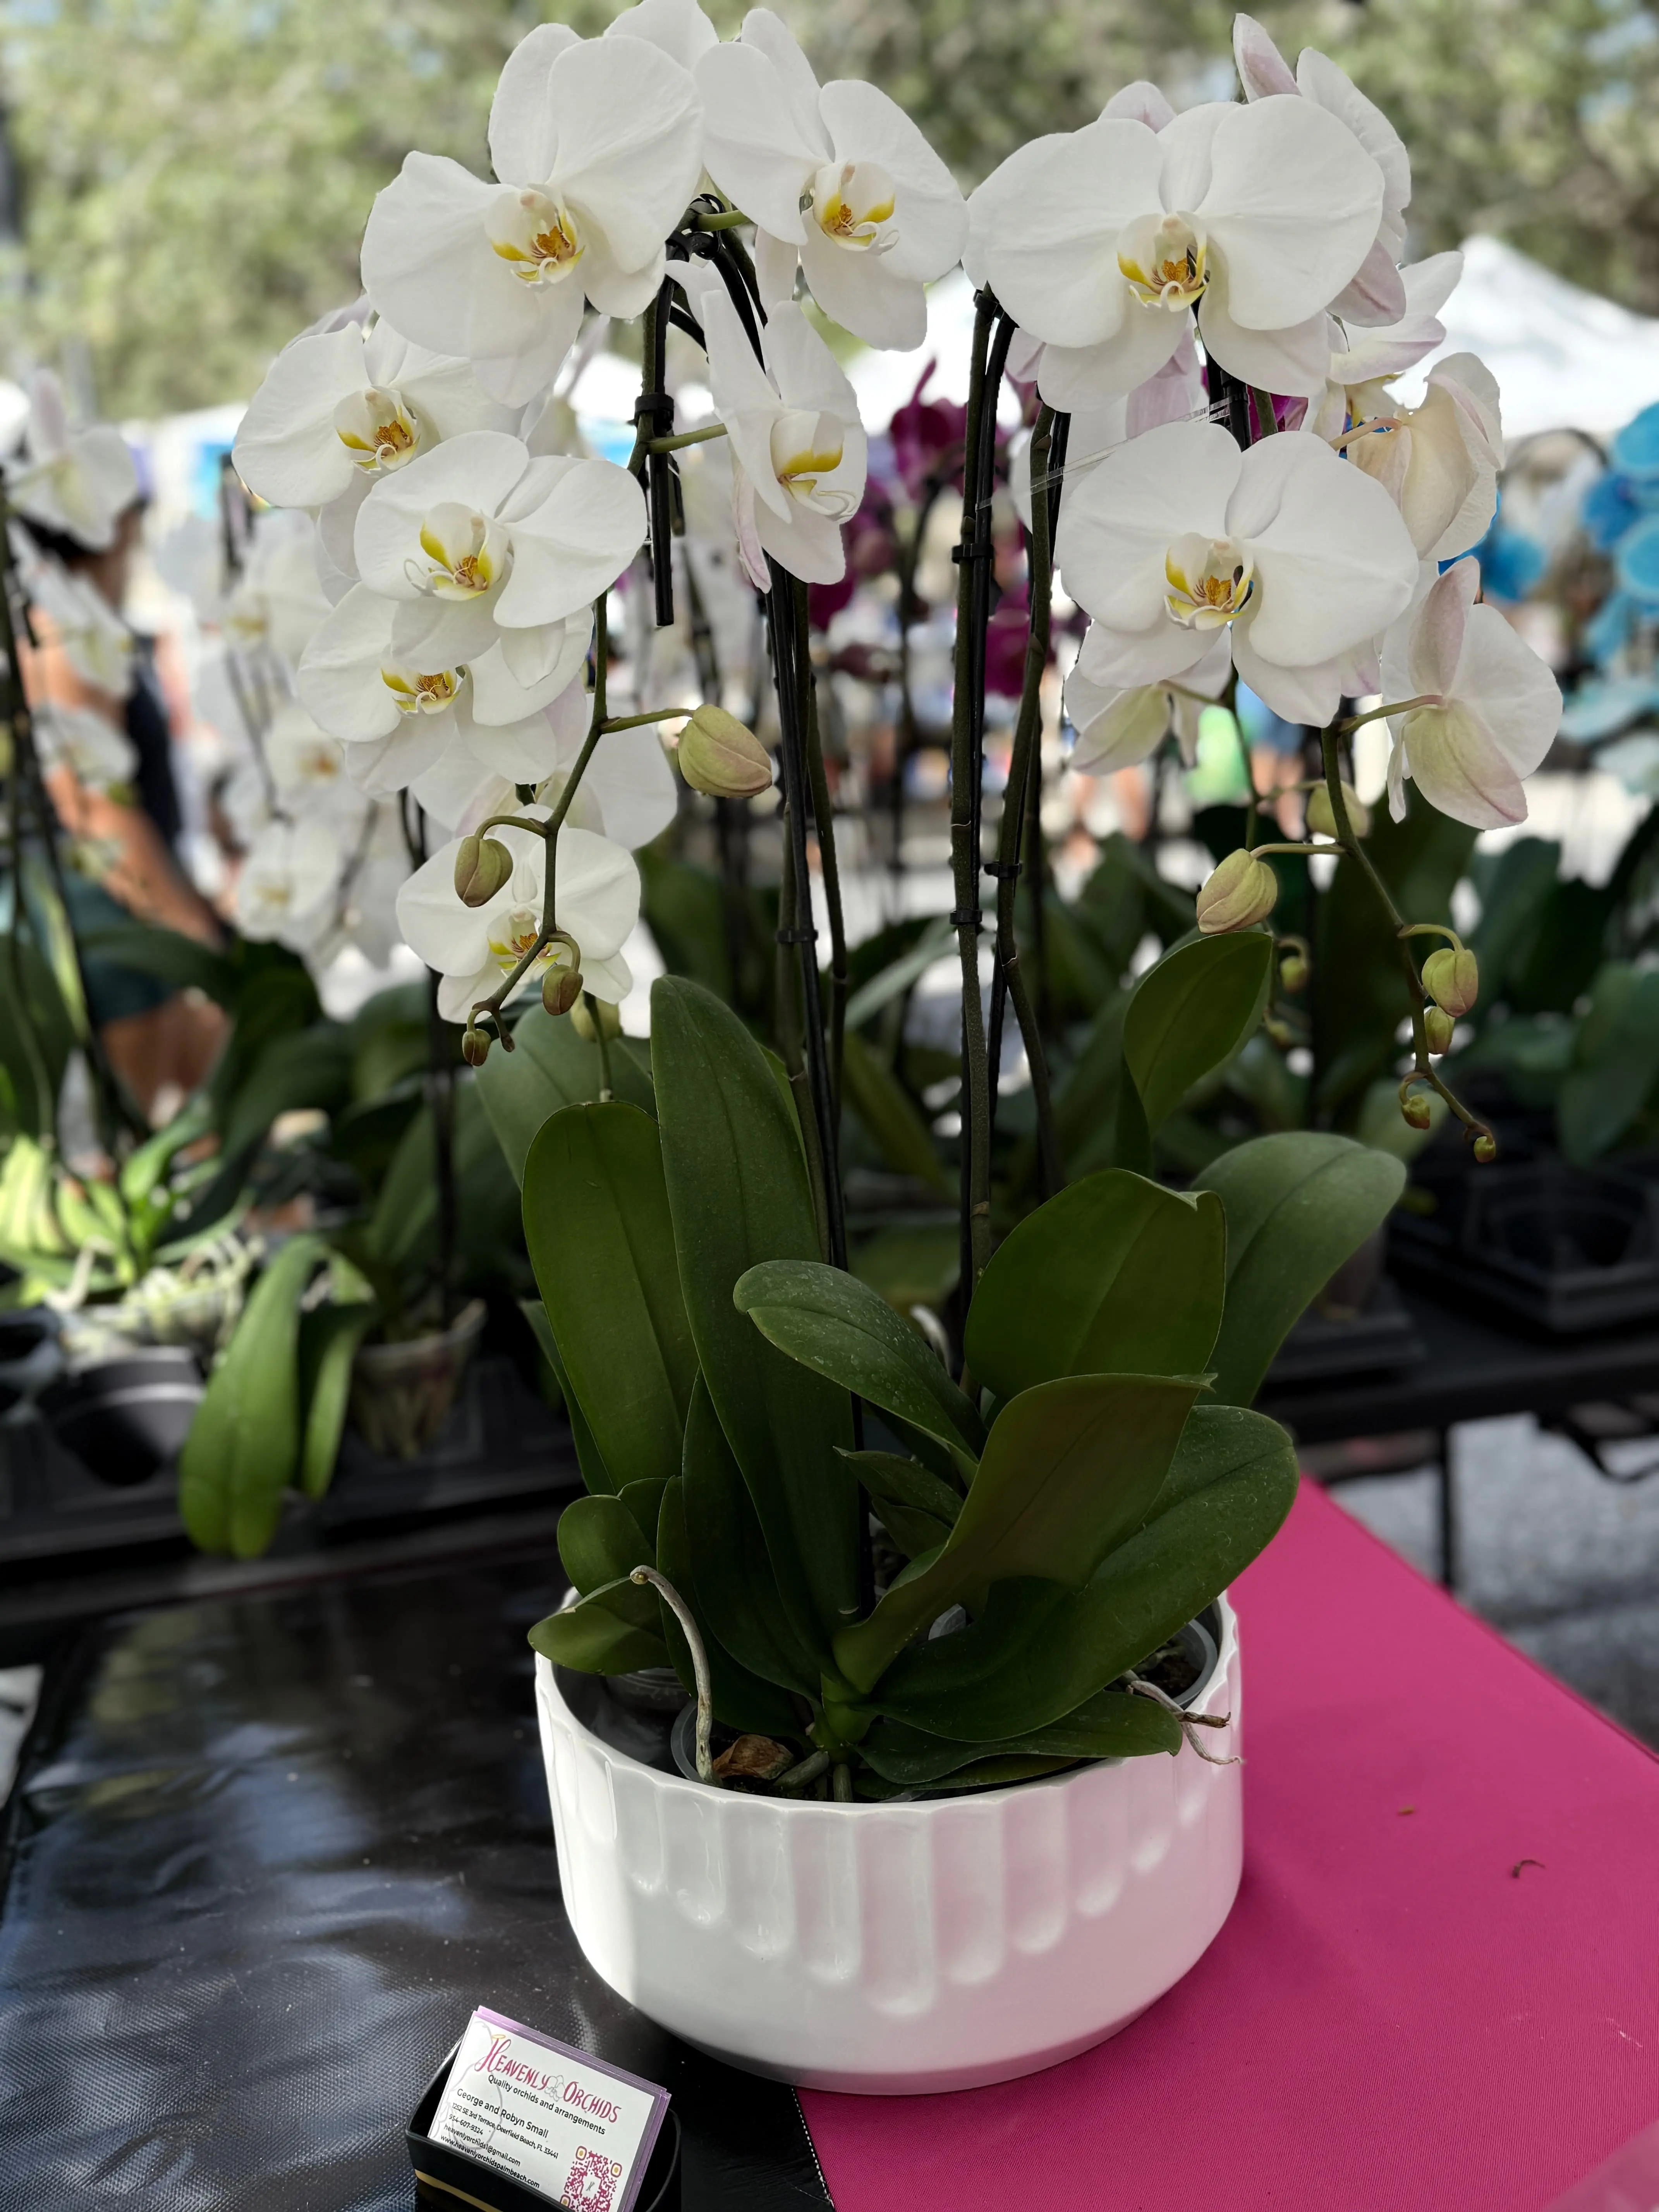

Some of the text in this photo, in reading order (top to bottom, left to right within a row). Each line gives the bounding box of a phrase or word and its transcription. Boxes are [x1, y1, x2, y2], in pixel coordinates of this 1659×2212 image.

[474, 2038, 622, 2123] HEAVENLY ORCHIDS
[488, 2075, 606, 2135] Quality orchids and arrangements
[449, 2114, 484, 2135] 954-607-9324
[457, 2088, 548, 2138] George and Robyn Small
[469, 2111, 477, 2119] 3rd
[477, 2115, 496, 2130] Terrace,
[496, 2124, 520, 2140] Deerfield
[519, 2135, 536, 2149] Beach,
[441, 2135, 540, 2188] www.heavenlyorchidspalmbeach.com
[444, 2123, 520, 2167] heavenlyorchids1@gmail.com
